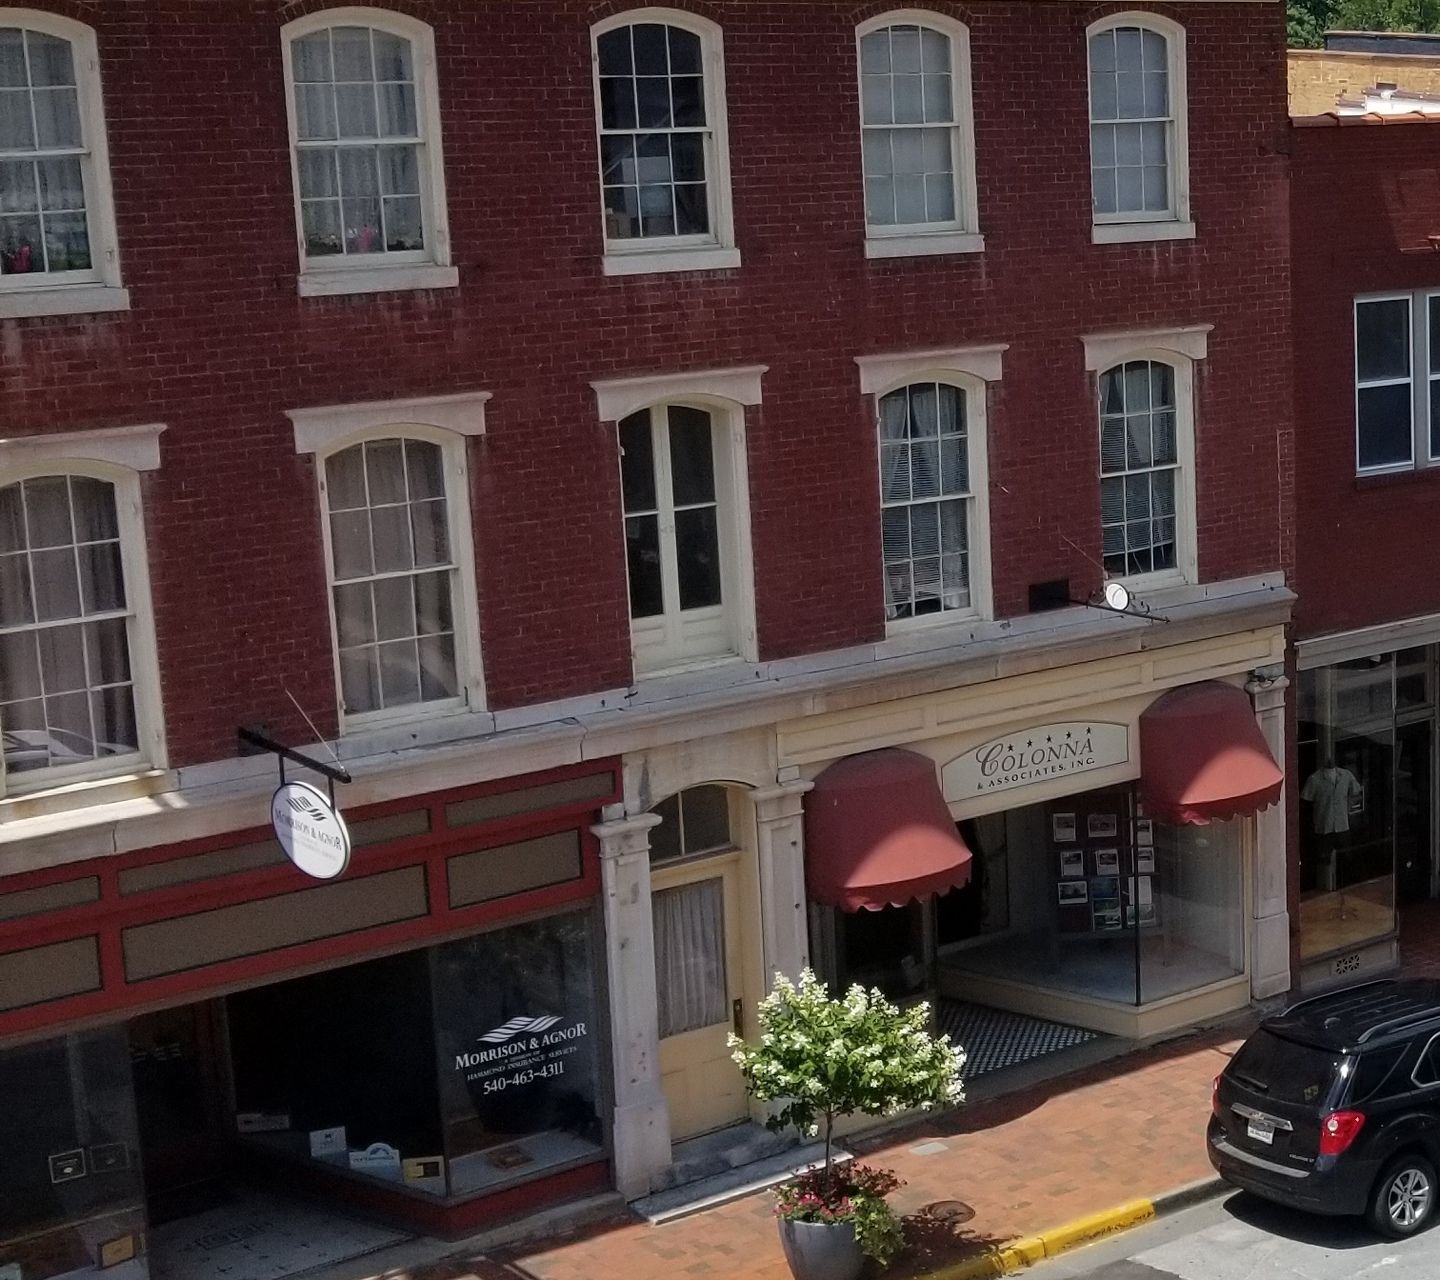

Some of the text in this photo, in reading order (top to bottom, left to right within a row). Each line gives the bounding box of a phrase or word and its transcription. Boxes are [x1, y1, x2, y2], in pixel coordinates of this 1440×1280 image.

[975, 738, 1094, 777] COLONNA
[455, 1022, 587, 1070] MORRISON & AGNOR
[483, 1061, 565, 1095] 540-463-4311
